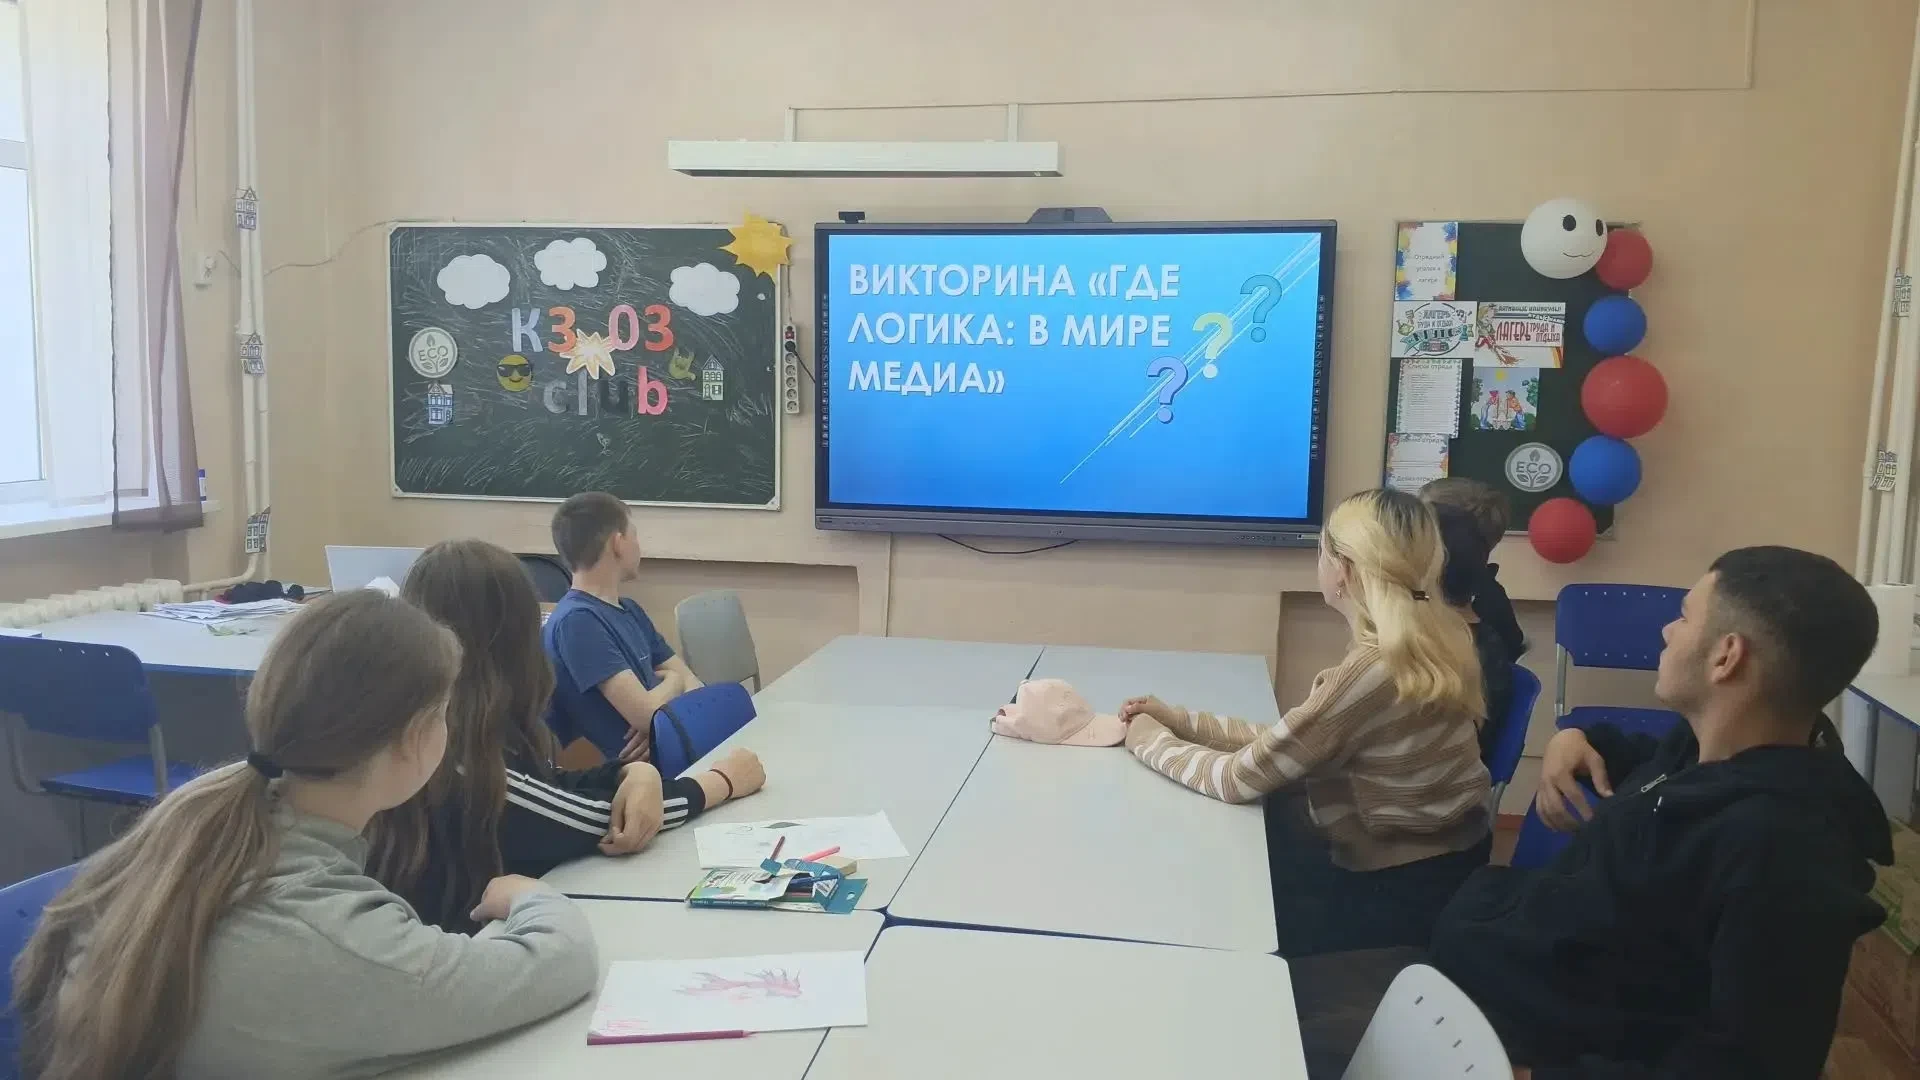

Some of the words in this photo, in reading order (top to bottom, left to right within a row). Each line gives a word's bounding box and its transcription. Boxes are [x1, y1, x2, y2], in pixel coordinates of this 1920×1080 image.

[848, 264, 1075, 297] ВИКТОРИНА
[1088, 263, 1181, 301] «ГДЕ
[1422, 310, 1451, 319] ЛАГЕРЬ
[847, 312, 1016, 347] ЛОГИКА:
[1028, 317, 1050, 347] В
[1061, 314, 1171, 348] МИРЕ
[1496, 321, 1531, 341] ЛАГЕРЬ
[1529, 322, 1549, 333] ТРУДА
[419, 345, 449, 361] ECO
[848, 361, 1006, 397] МЕДИА»
[543, 366, 669, 416] club
[1516, 461, 1552, 475] ECO
